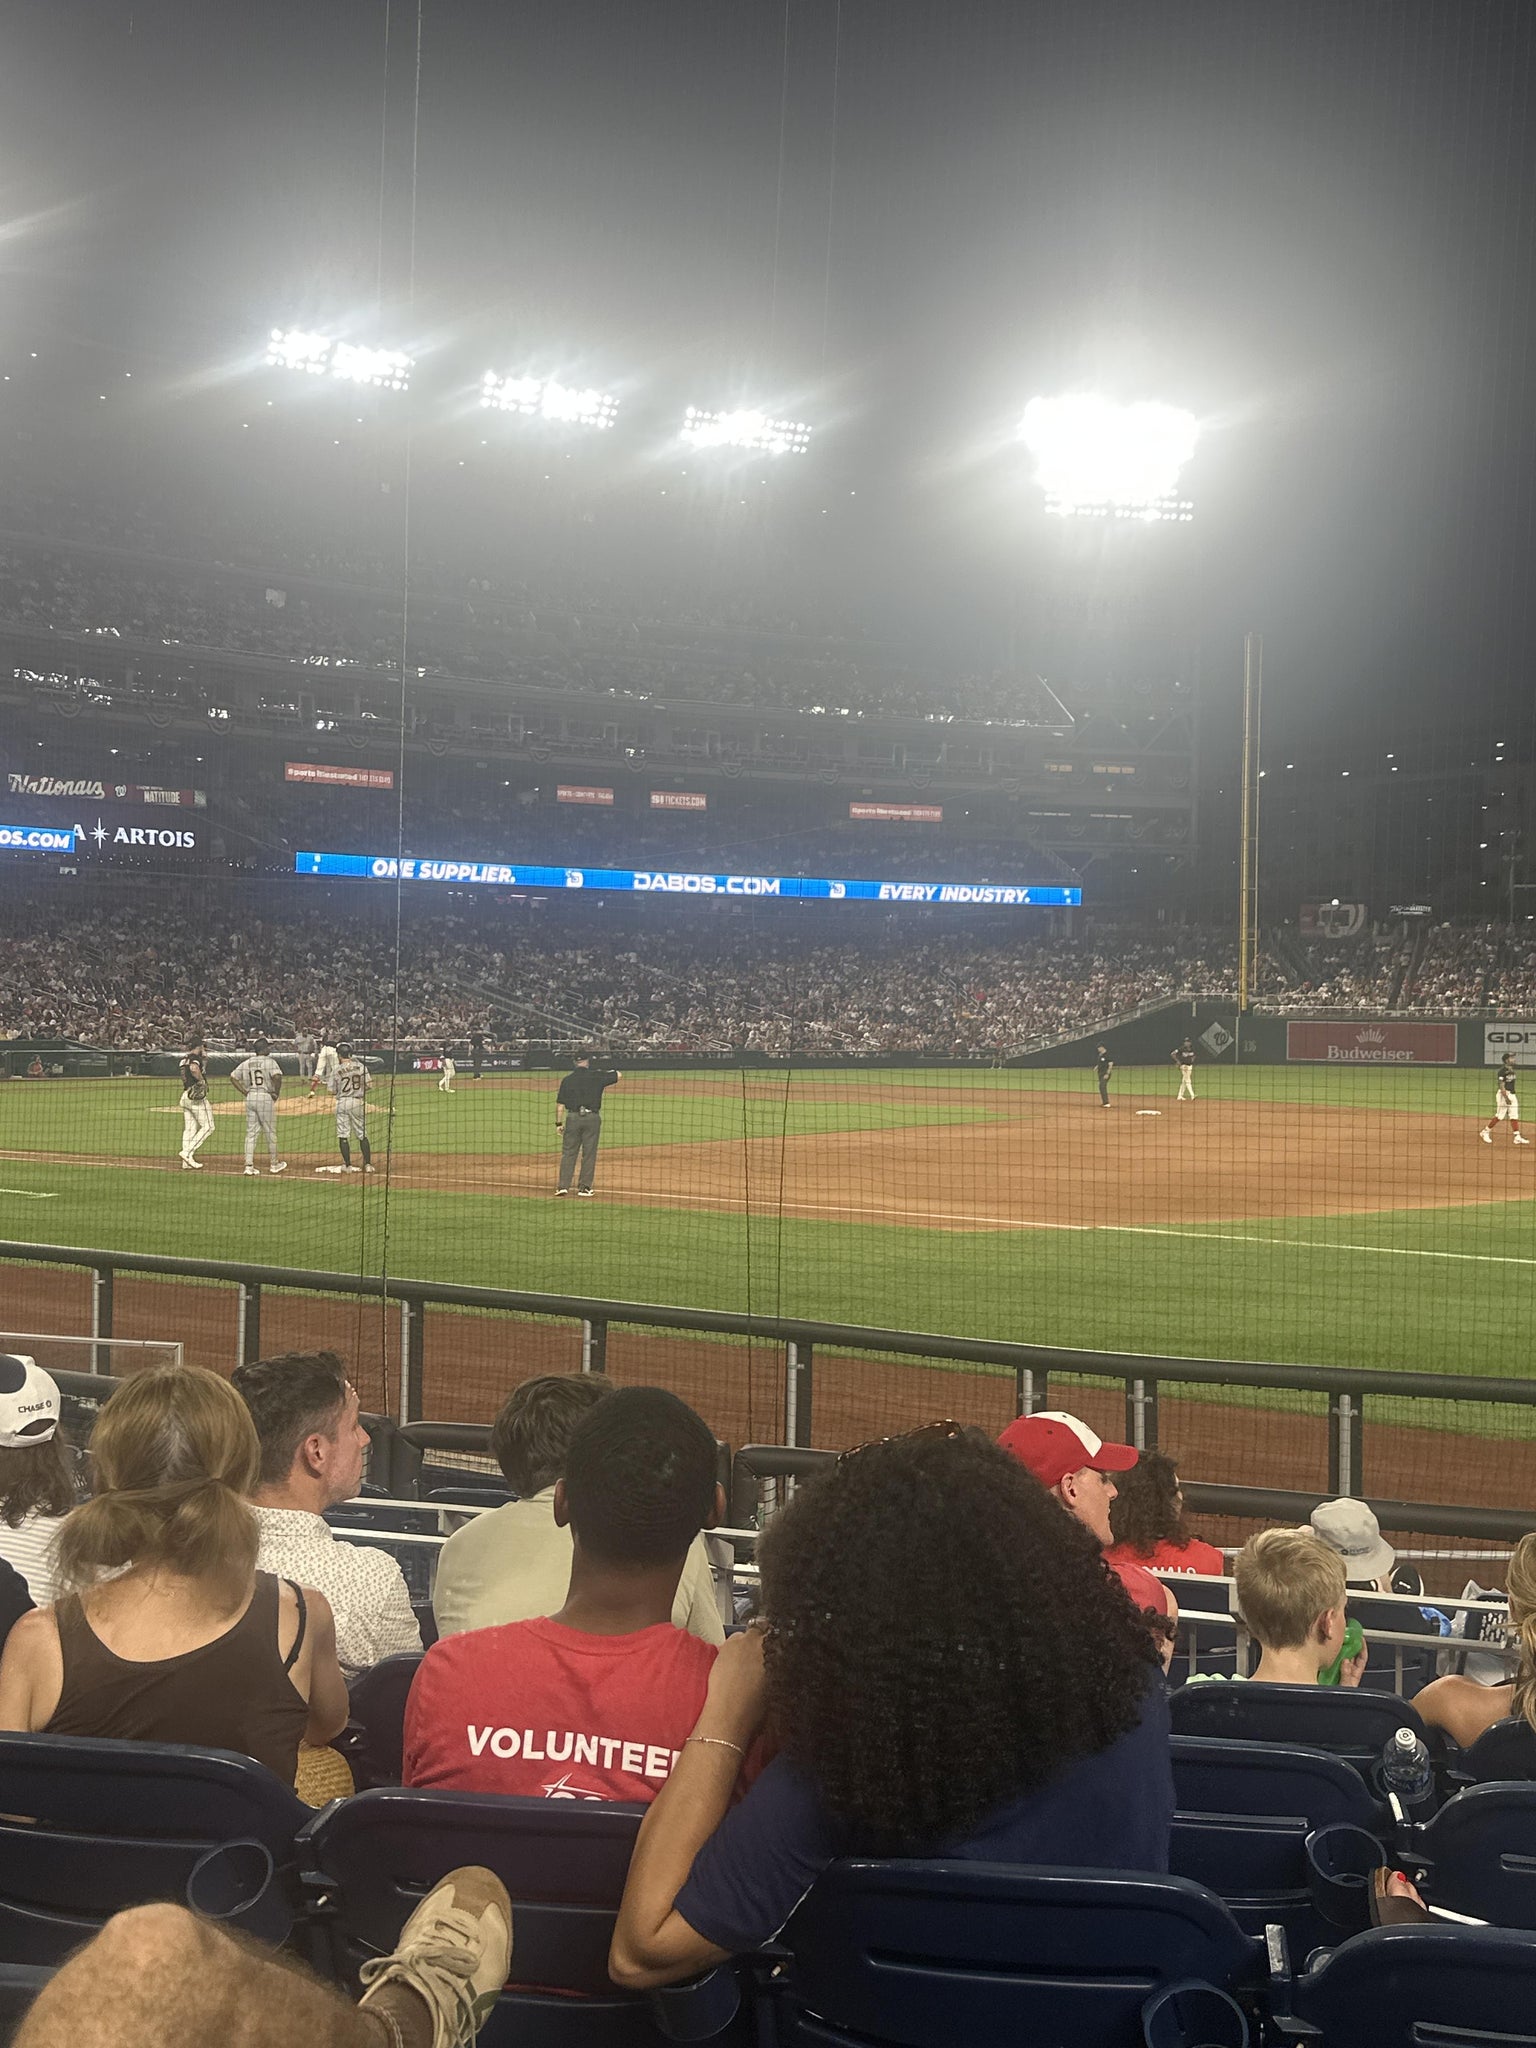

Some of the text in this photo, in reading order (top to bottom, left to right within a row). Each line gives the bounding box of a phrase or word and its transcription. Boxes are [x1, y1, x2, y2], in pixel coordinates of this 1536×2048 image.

[8, 773, 105, 799] Nationals
[144, 790, 180, 804] NATITUDE
[665, 796, 706, 807] TICKETS.COM
[113, 827, 195, 848] ARTOIS
[372, 860, 516, 883] ONE SUPPLIER.
[633, 872, 780, 895] DABOS.COM
[879, 885, 1031, 903] EVERY INDUSTRY.
[248, 1070, 264, 1086] 16
[341, 1075, 361, 1092] 28
[18, 1401, 45, 1413] CHASE
